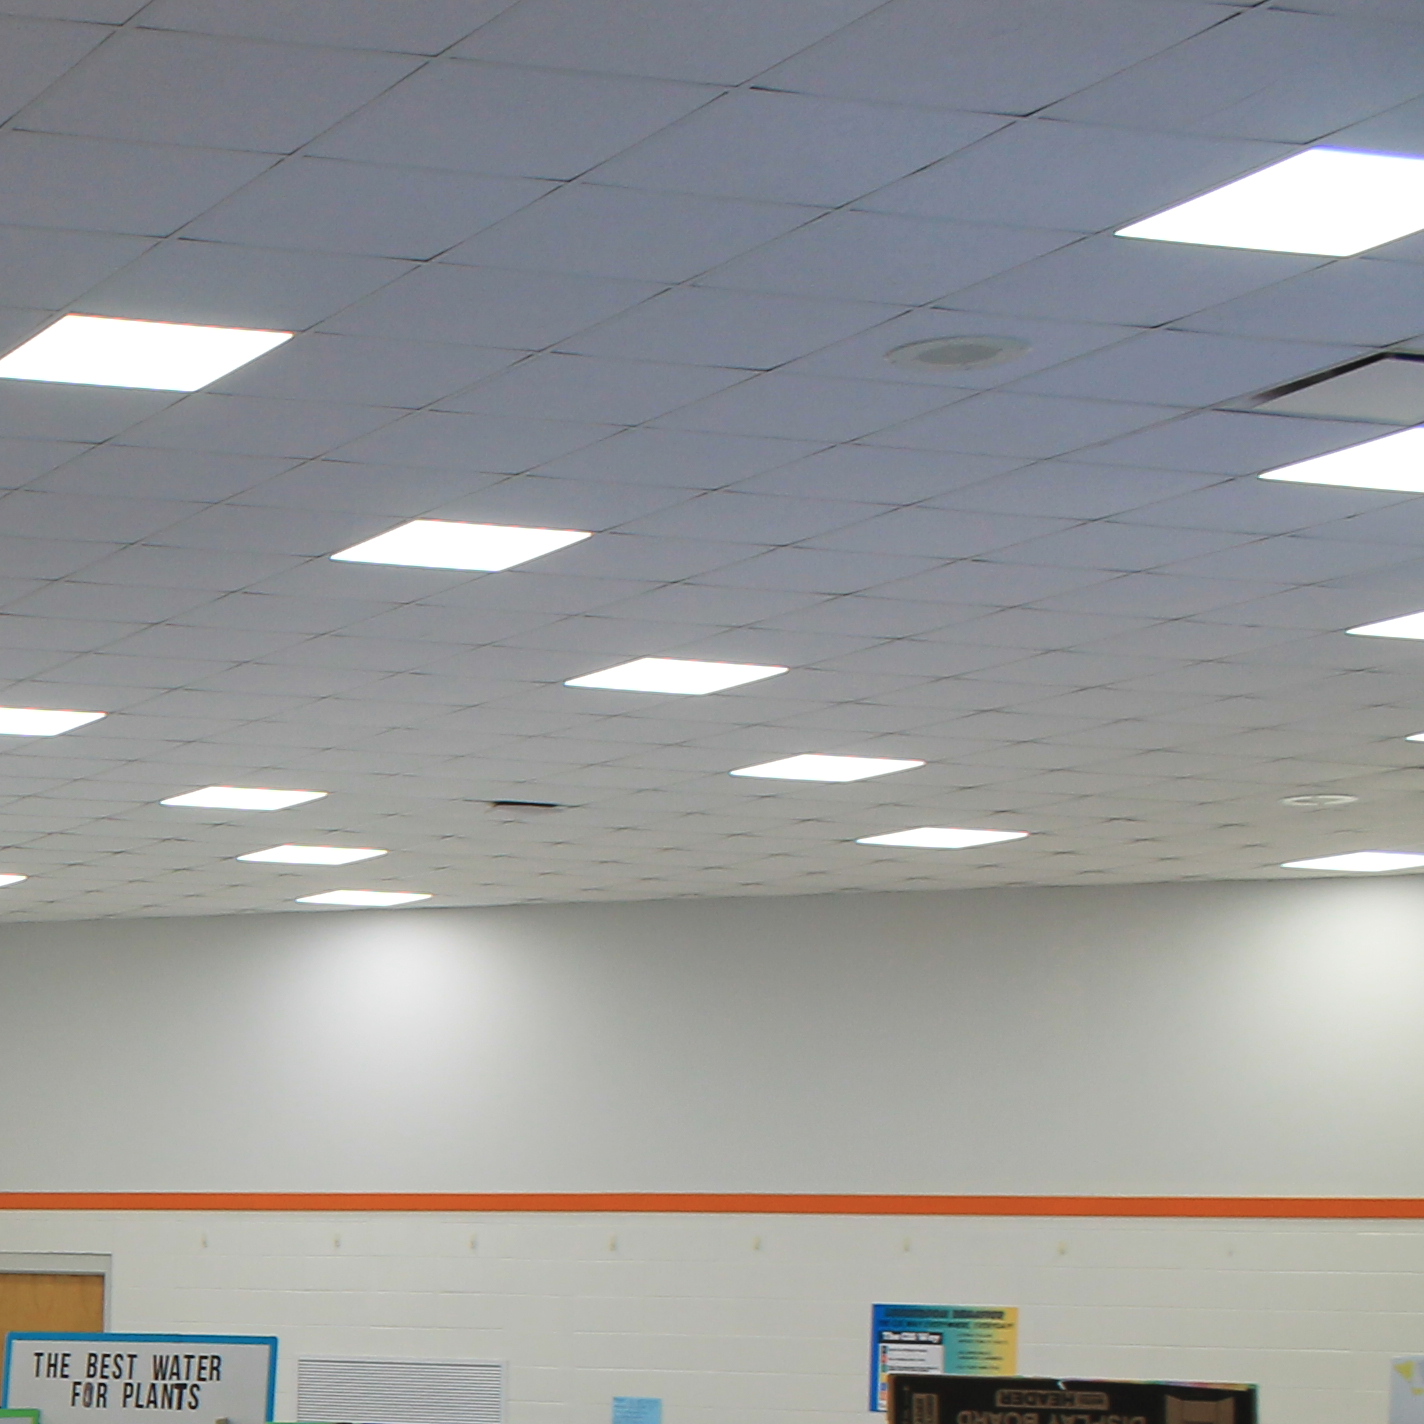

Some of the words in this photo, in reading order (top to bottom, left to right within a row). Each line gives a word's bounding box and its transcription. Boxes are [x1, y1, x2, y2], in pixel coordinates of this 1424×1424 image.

[34, 1352, 71, 1378] THE
[86, 1353, 137, 1380] BEST
[153, 1354, 221, 1381] WATER
[71, 1382, 107, 1409] FOR
[122, 1383, 201, 1411] PLANTS
